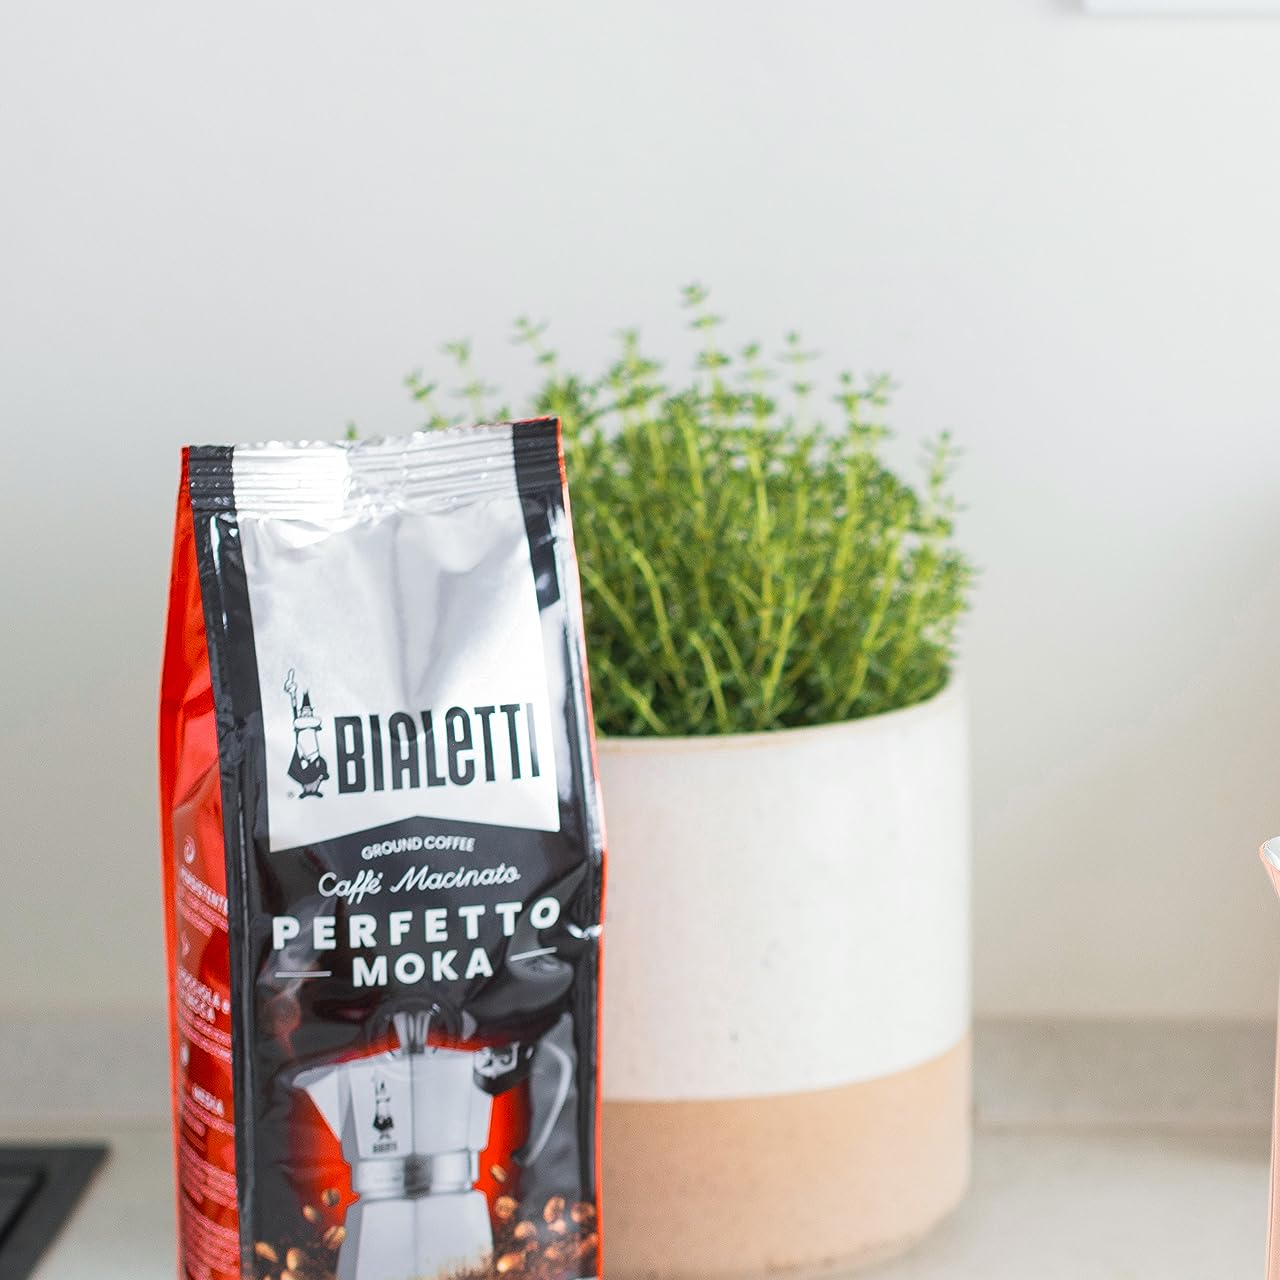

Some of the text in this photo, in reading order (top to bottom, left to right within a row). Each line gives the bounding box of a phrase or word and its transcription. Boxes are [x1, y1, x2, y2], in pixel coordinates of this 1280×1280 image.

[361, 835, 476, 860] GROUND COFFEE
[390, 863, 522, 893] Macinato
[272, 897, 560, 950] PERFETTO
[353, 948, 494, 988] MOKA
